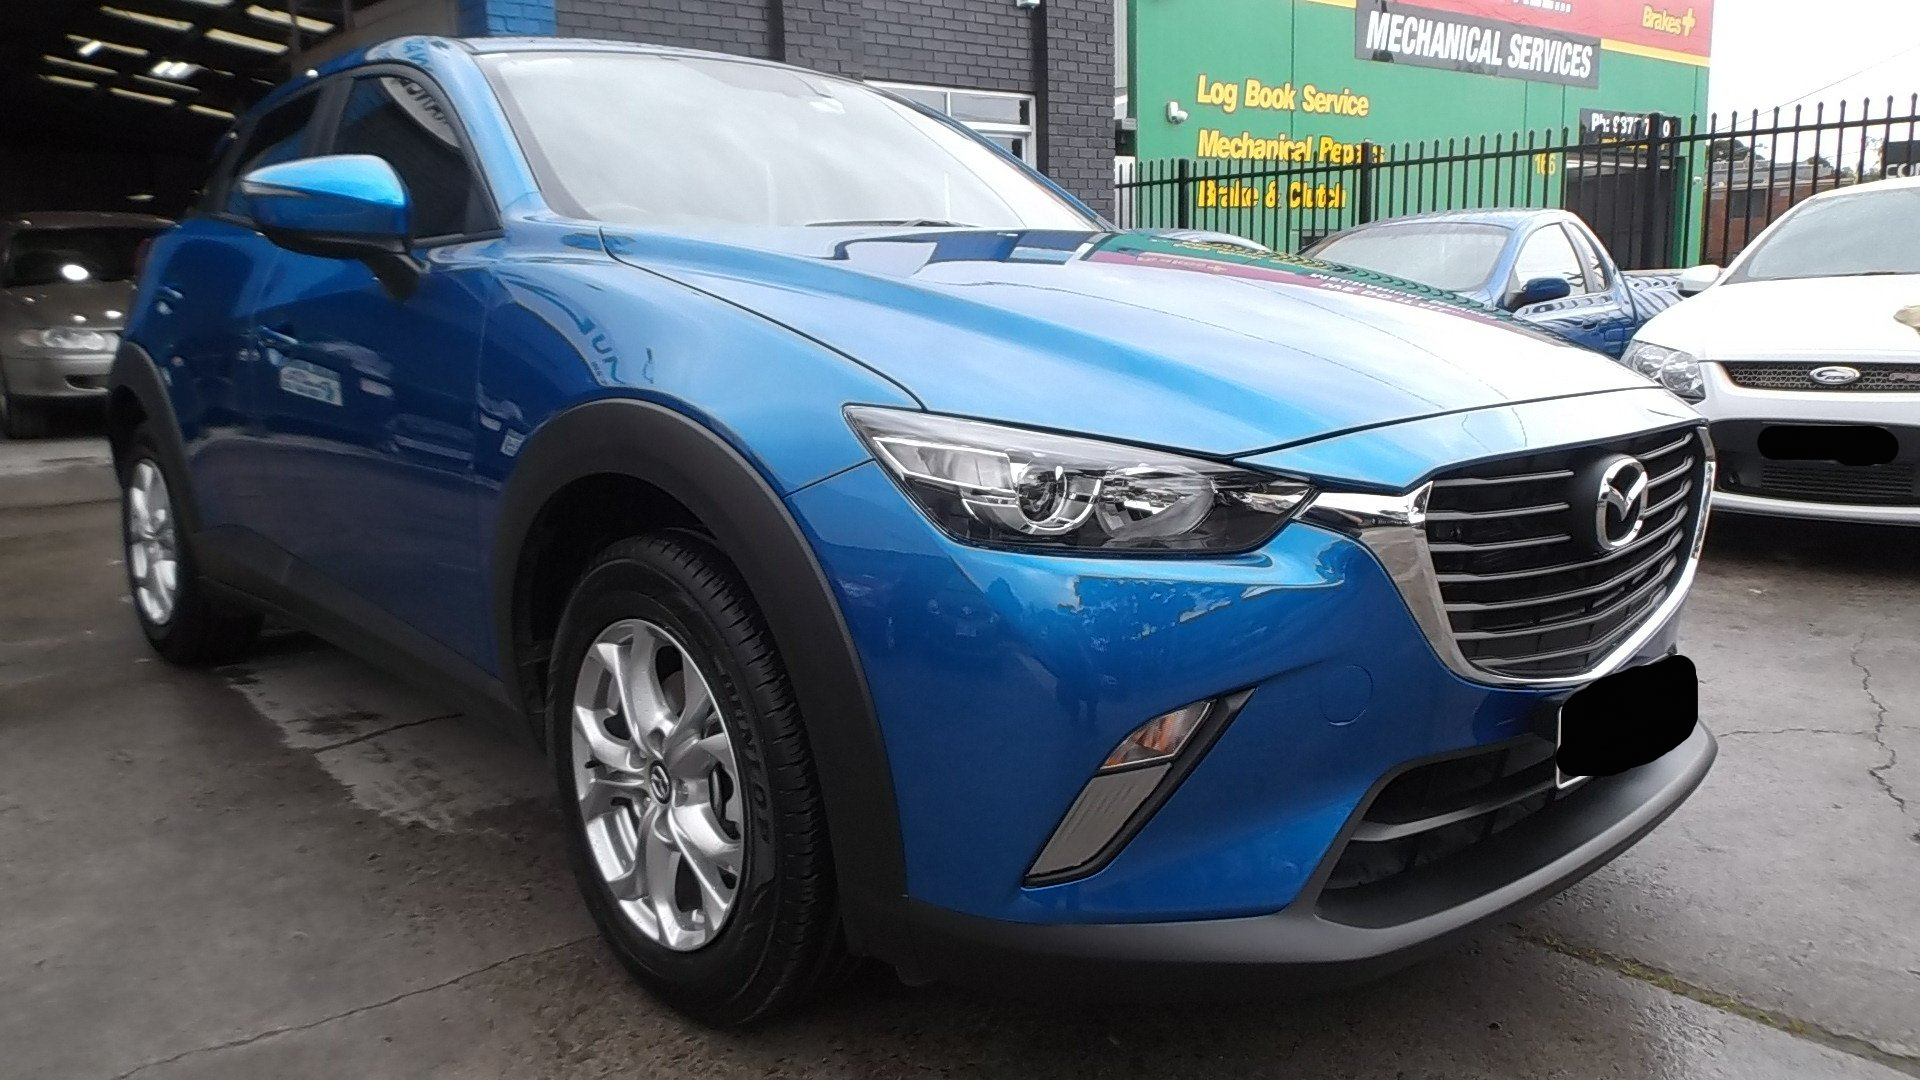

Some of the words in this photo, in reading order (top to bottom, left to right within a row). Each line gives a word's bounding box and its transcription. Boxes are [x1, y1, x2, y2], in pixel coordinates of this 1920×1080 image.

[1365, 10, 1503, 66] MECHANICAL
[1507, 33, 1593, 79] SERVICES
[1197, 73, 1239, 114] Log
[1244, 77, 1298, 111] Book
[1301, 83, 1370, 117] Service
[1197, 128, 1313, 162] Mechanical
[1318, 134, 1386, 165] Repas
[1197, 179, 1260, 208] Brake
[1289, 180, 1347, 208] Clutch
